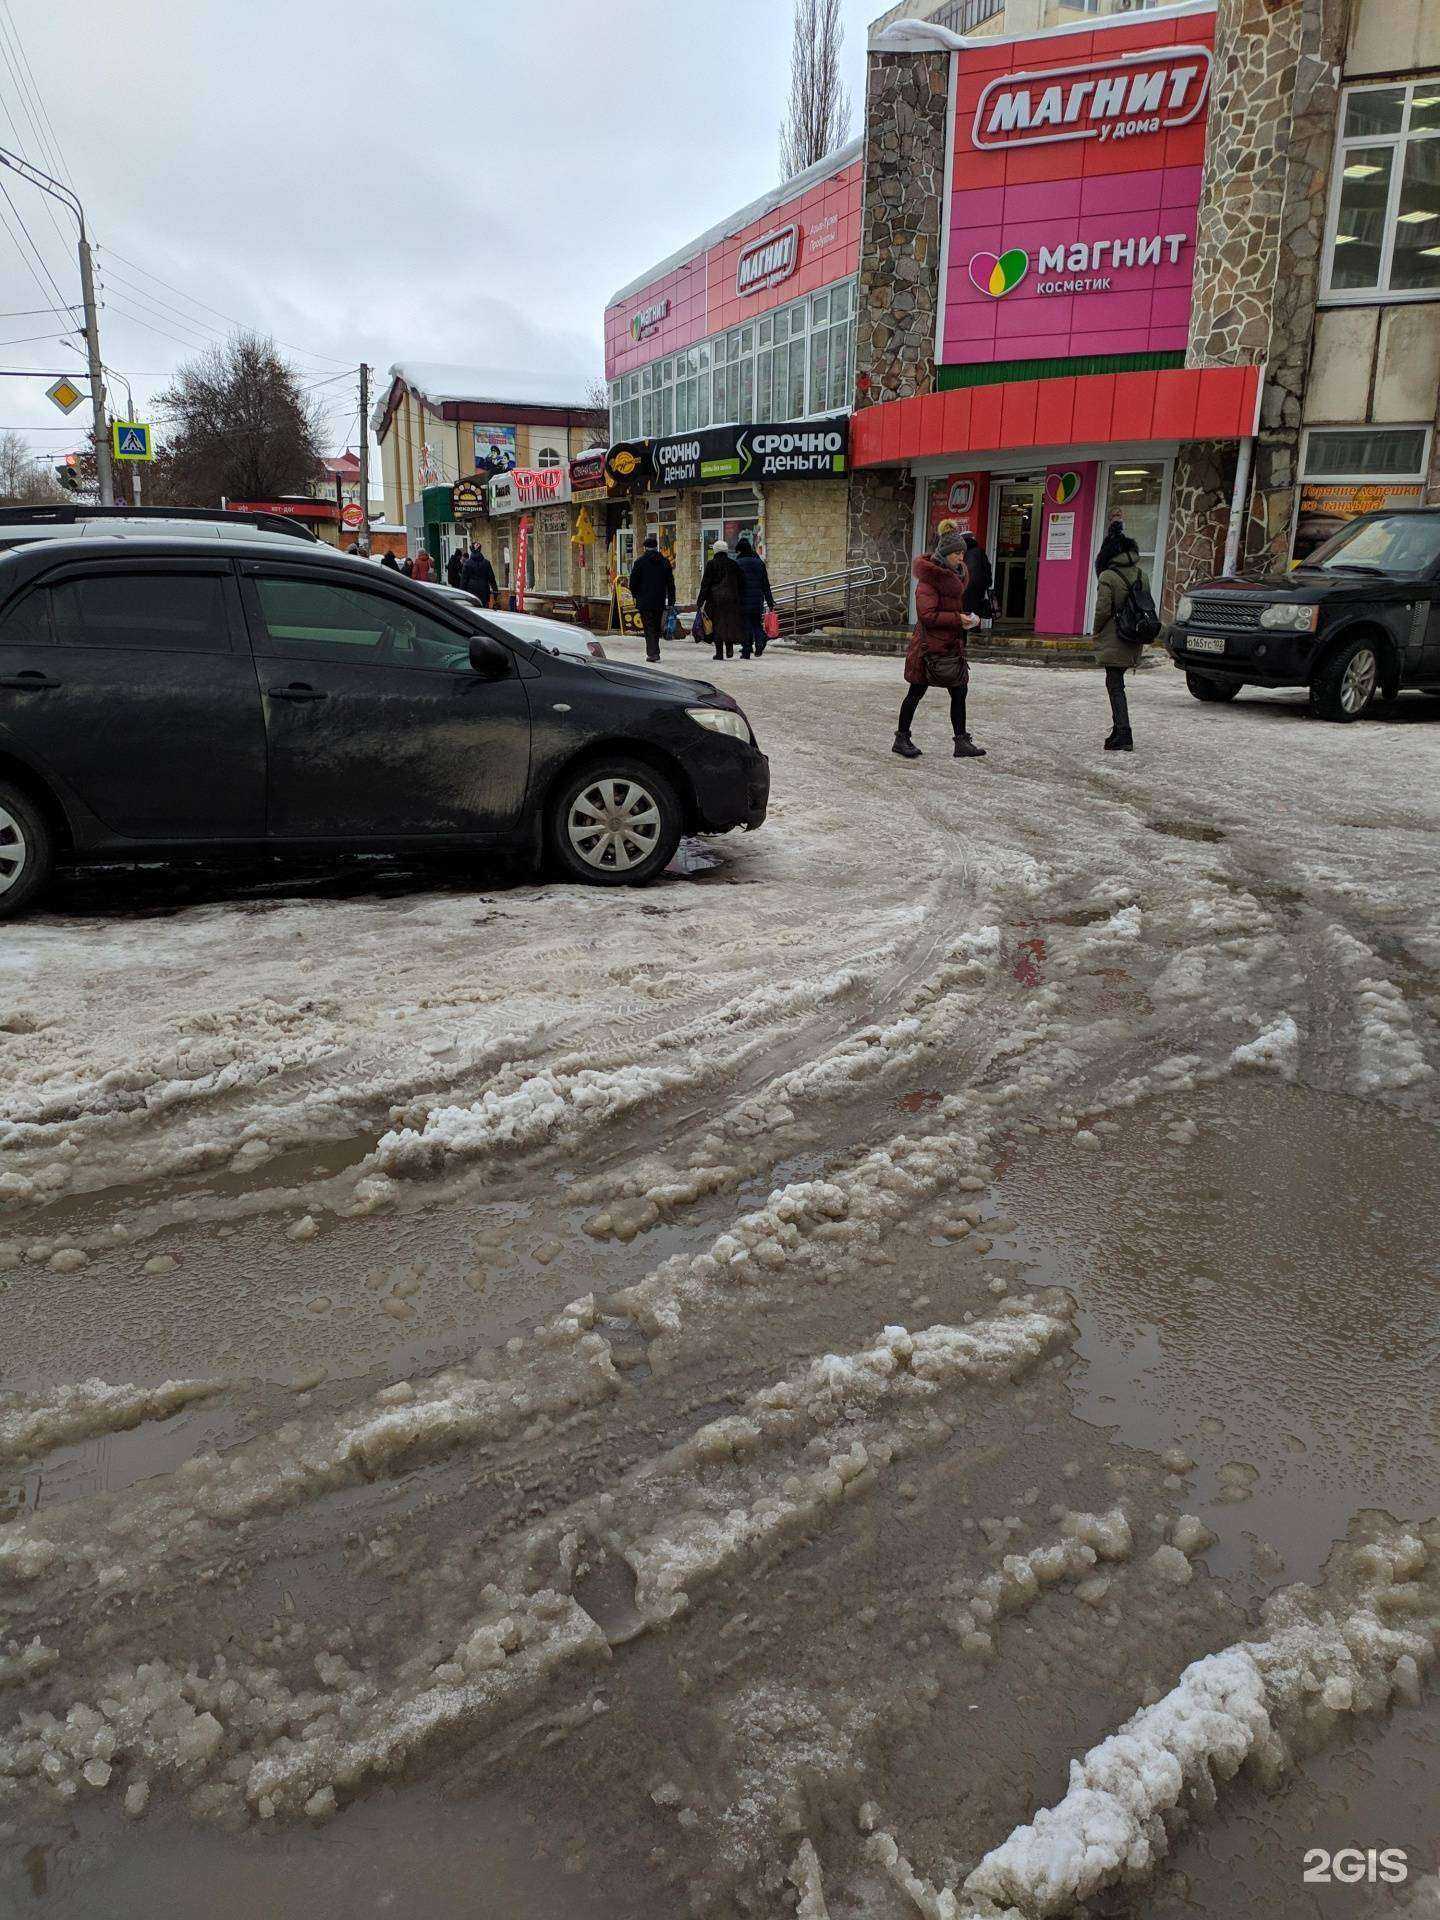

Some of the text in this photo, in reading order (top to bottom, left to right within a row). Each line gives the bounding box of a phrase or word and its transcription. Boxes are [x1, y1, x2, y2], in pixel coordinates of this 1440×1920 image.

[987, 66, 1198, 133] МАГНИТ
[1099, 117, 1160, 142] у дома
[740, 236, 793, 286] МАГНИТ
[1038, 233, 1187, 275] магнит
[1037, 278, 1111, 294] косметик
[659, 440, 701, 465] СРОЧНО
[752, 432, 842, 454] СРОЧНО
[664, 462, 696, 485] деньги
[762, 454, 831, 474] деньги
[1302, 485, 1358, 499] Горячие
